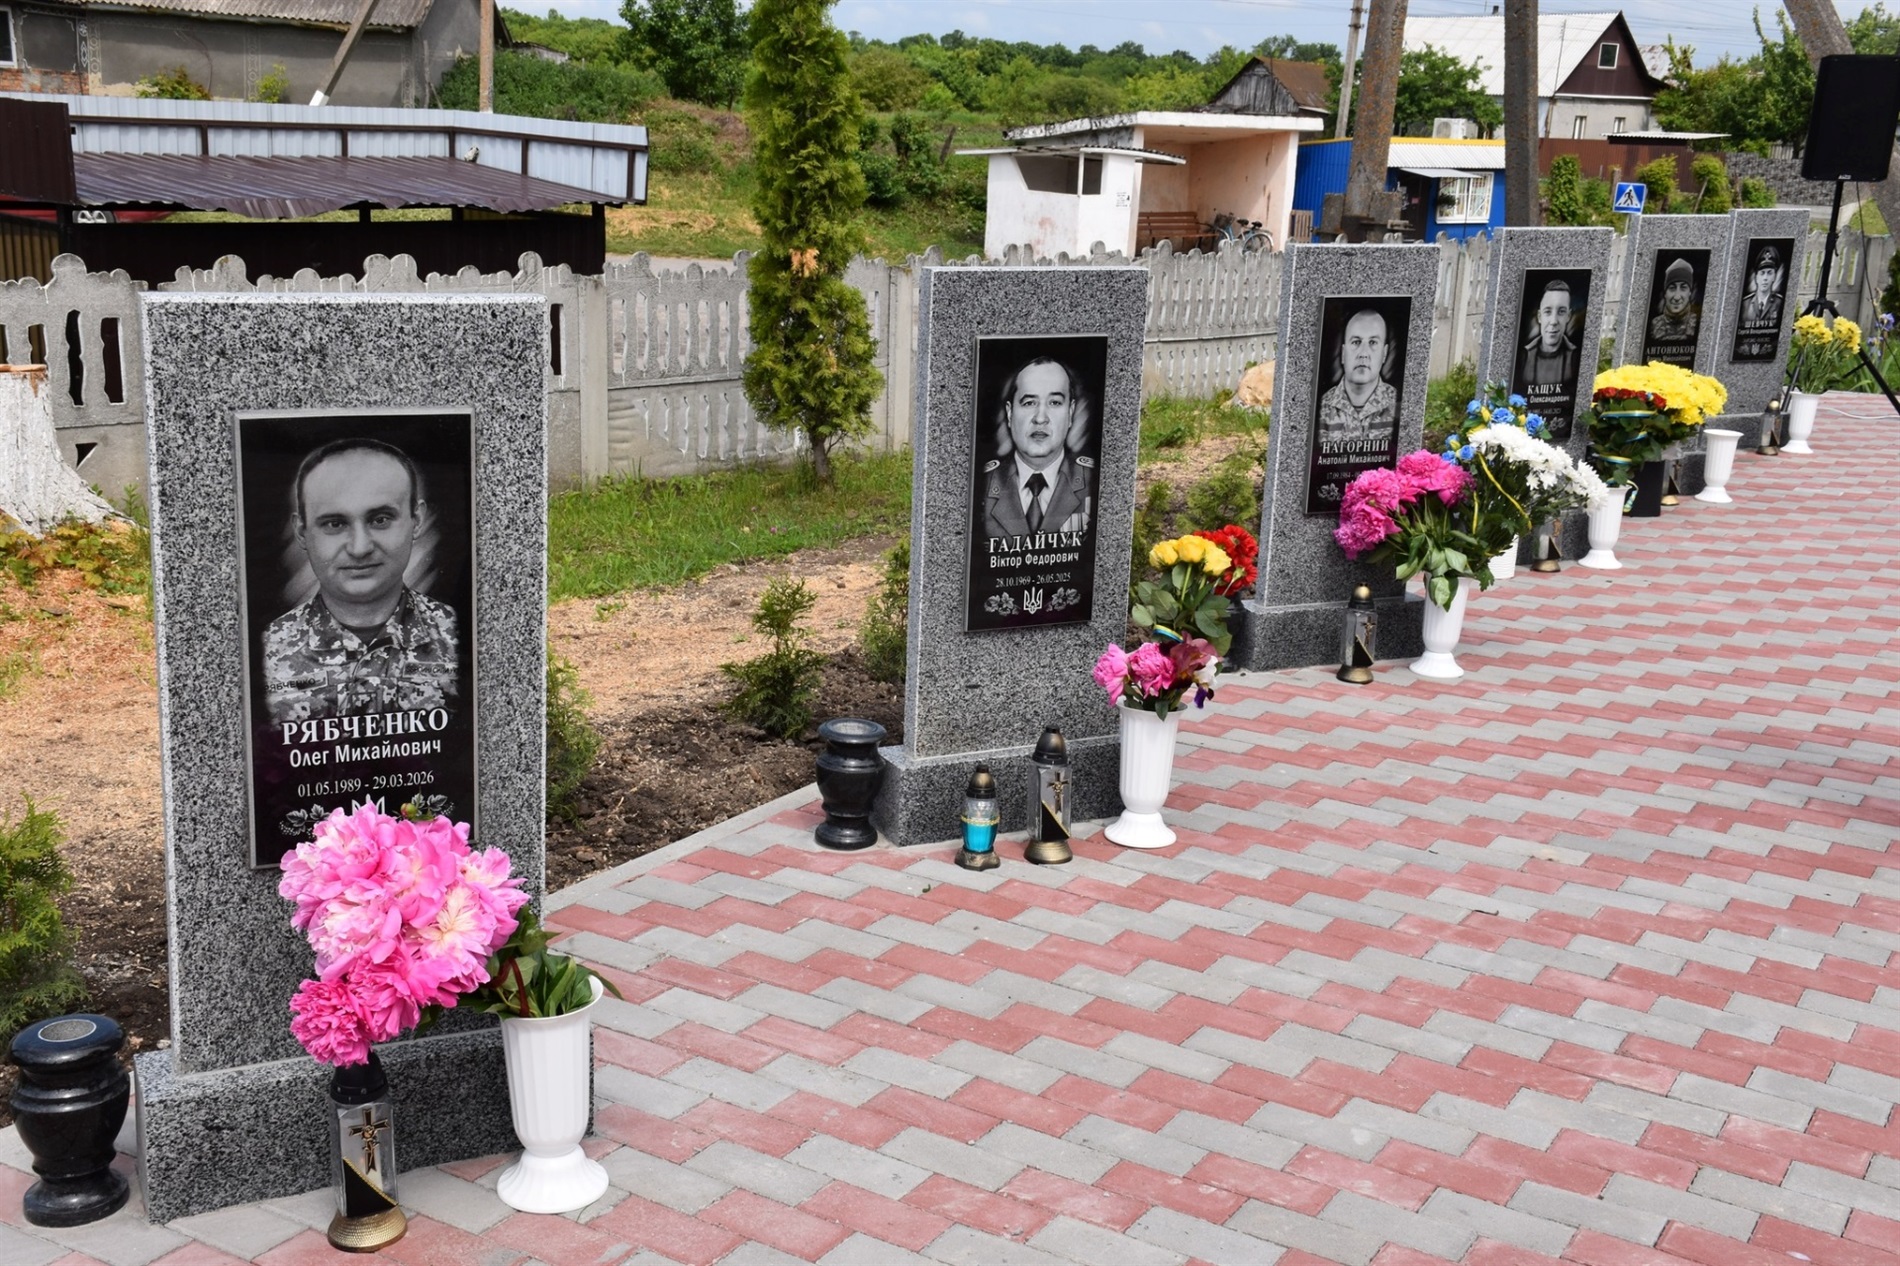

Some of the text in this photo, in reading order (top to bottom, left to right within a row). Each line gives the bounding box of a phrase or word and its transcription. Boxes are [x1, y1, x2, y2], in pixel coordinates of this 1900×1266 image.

[1527, 383, 1563, 395] КАЩУК
[1529, 395, 1570, 404] Олександрович
[1322, 438, 1389, 454] НАГОРНИЙ
[1317, 454, 1391, 466] Анатолій Михайлович
[988, 530, 1083, 554] ГАДАЙЧУК
[990, 552, 1080, 569] Віктор Федорович
[1036, 572, 1071, 585] 26.05.2025
[281, 707, 449, 746] РЯБЧЕНКО
[289, 739, 442, 768] Олег Михайлович
[297, 778, 362, 798] 01.05.1989
[372, 770, 435, 790] 29.03.2026
